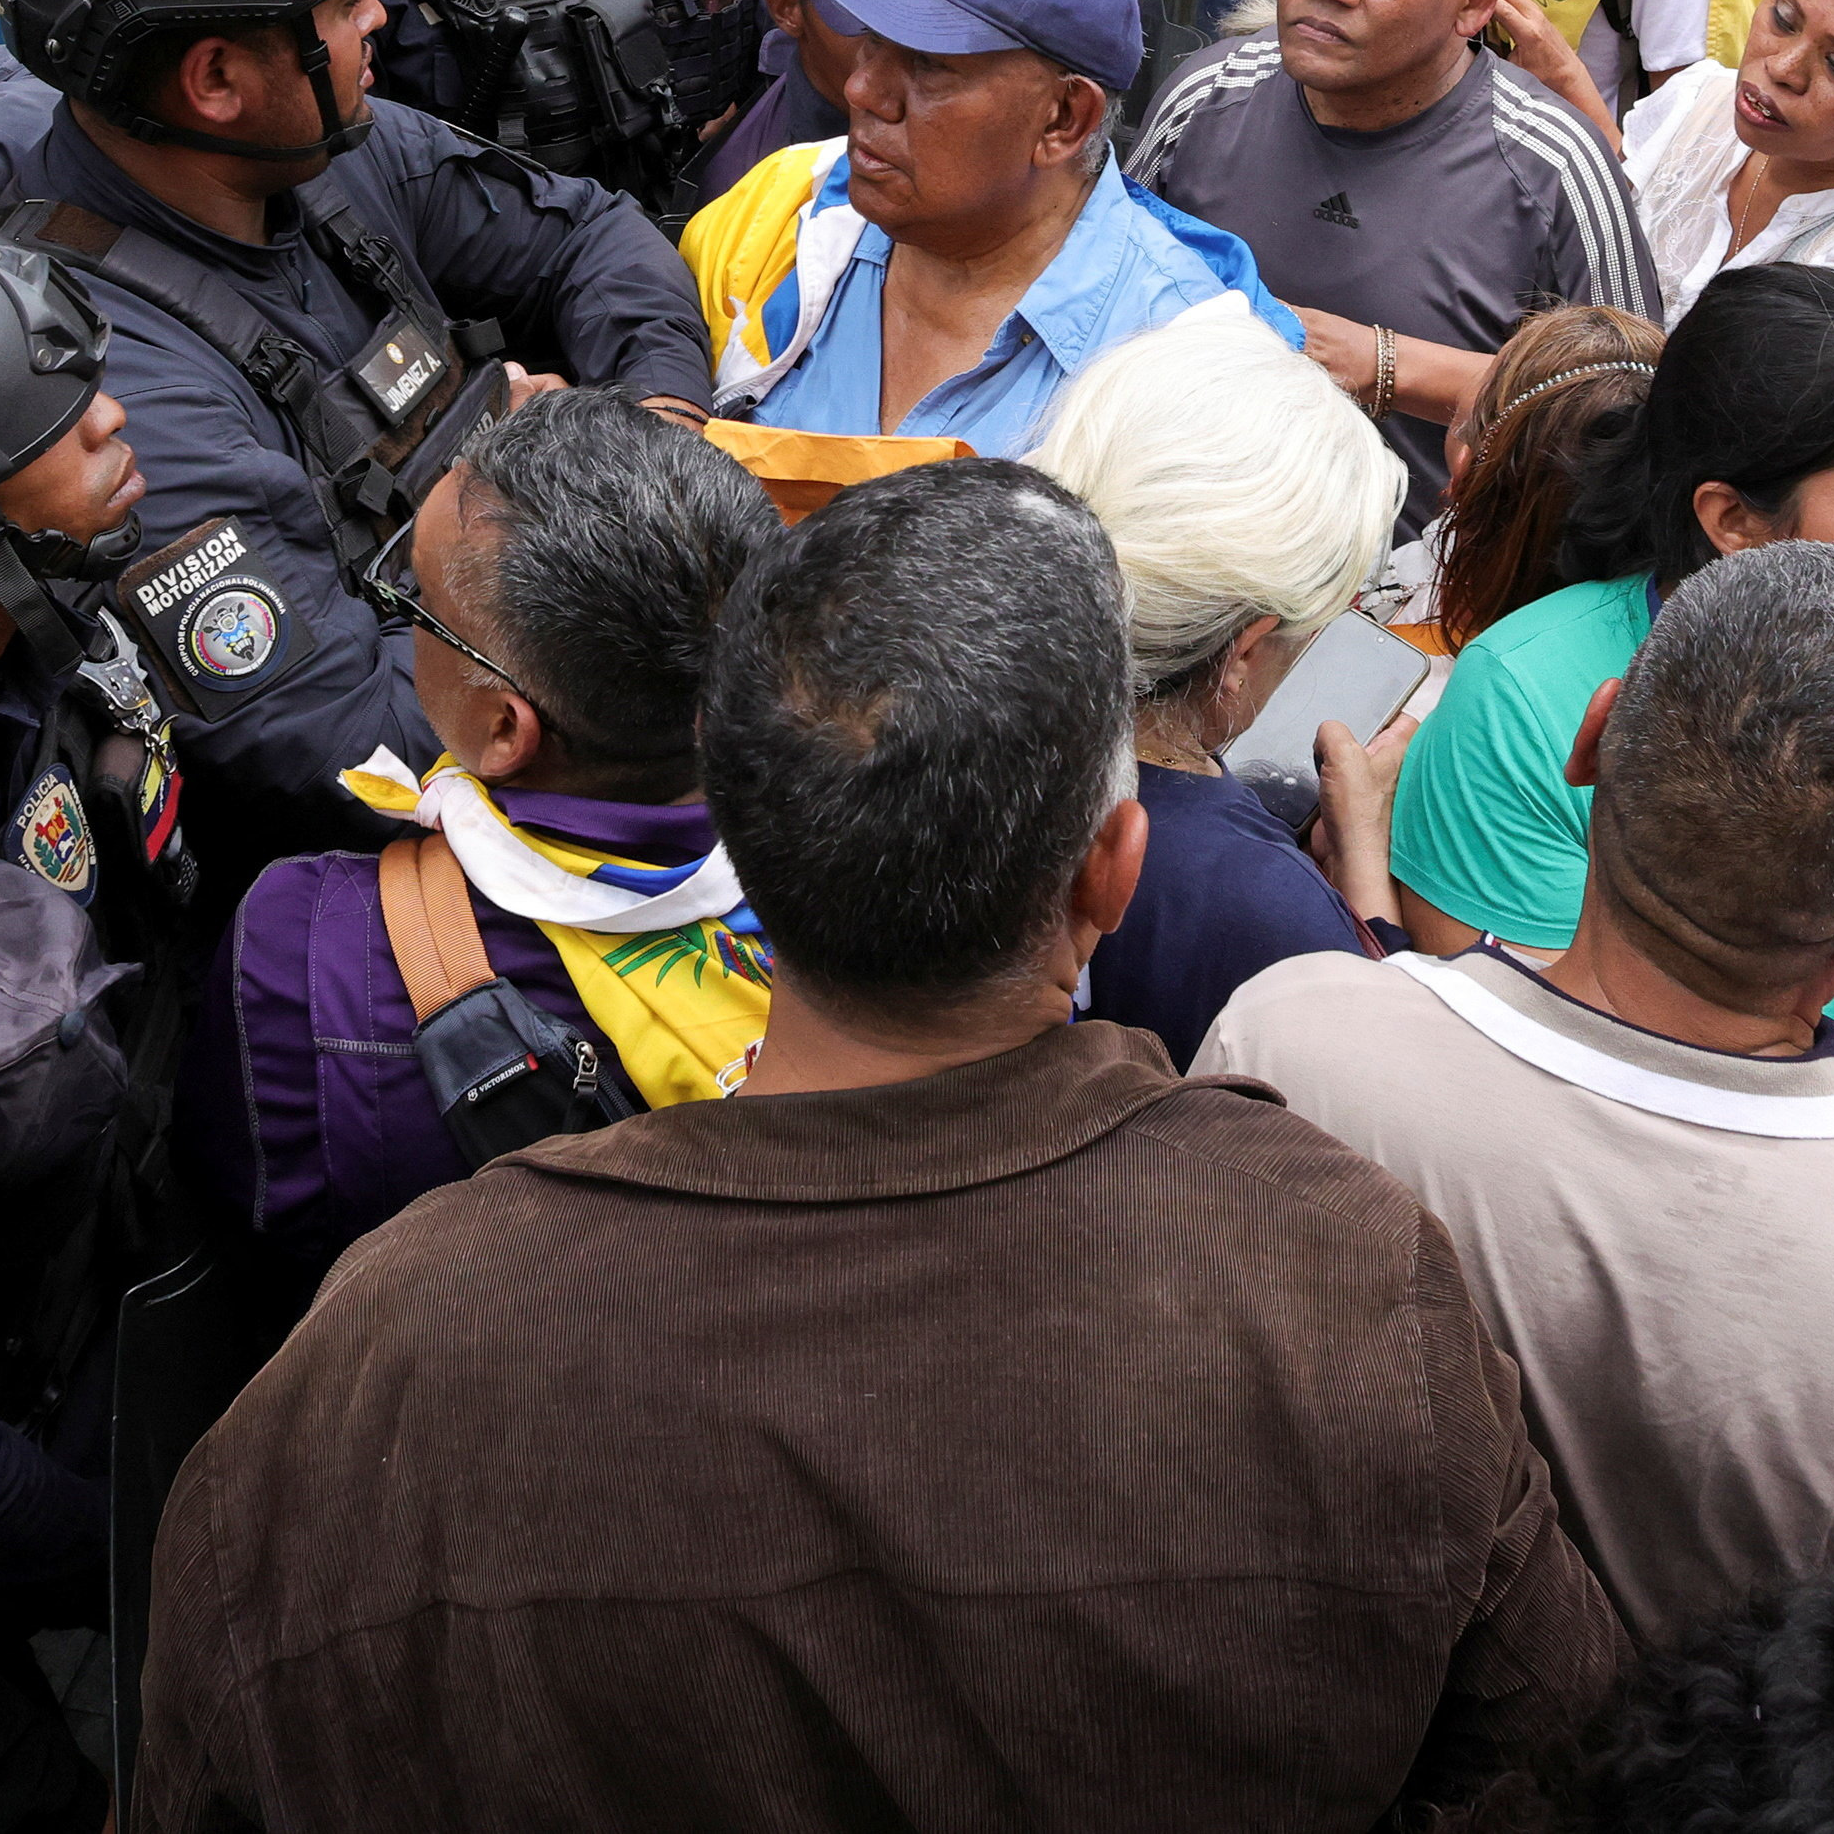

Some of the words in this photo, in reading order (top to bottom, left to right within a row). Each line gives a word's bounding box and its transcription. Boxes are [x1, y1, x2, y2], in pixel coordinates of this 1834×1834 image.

[1313, 207, 1360, 230] adidas
[385, 360, 431, 414] JIMENEZ
[135, 526, 239, 605] DIVISION
[145, 541, 248, 617] MOTORIZADA
[199, 577, 243, 600] NACIONAL
[242, 577, 287, 615] BOLIVARIANA
[179, 597, 203, 631] POLICIA
[178, 644, 199, 677] CUERPO
[17, 774, 59, 831] POLICIA
[478, 1062, 526, 1094] VICTORINOX
